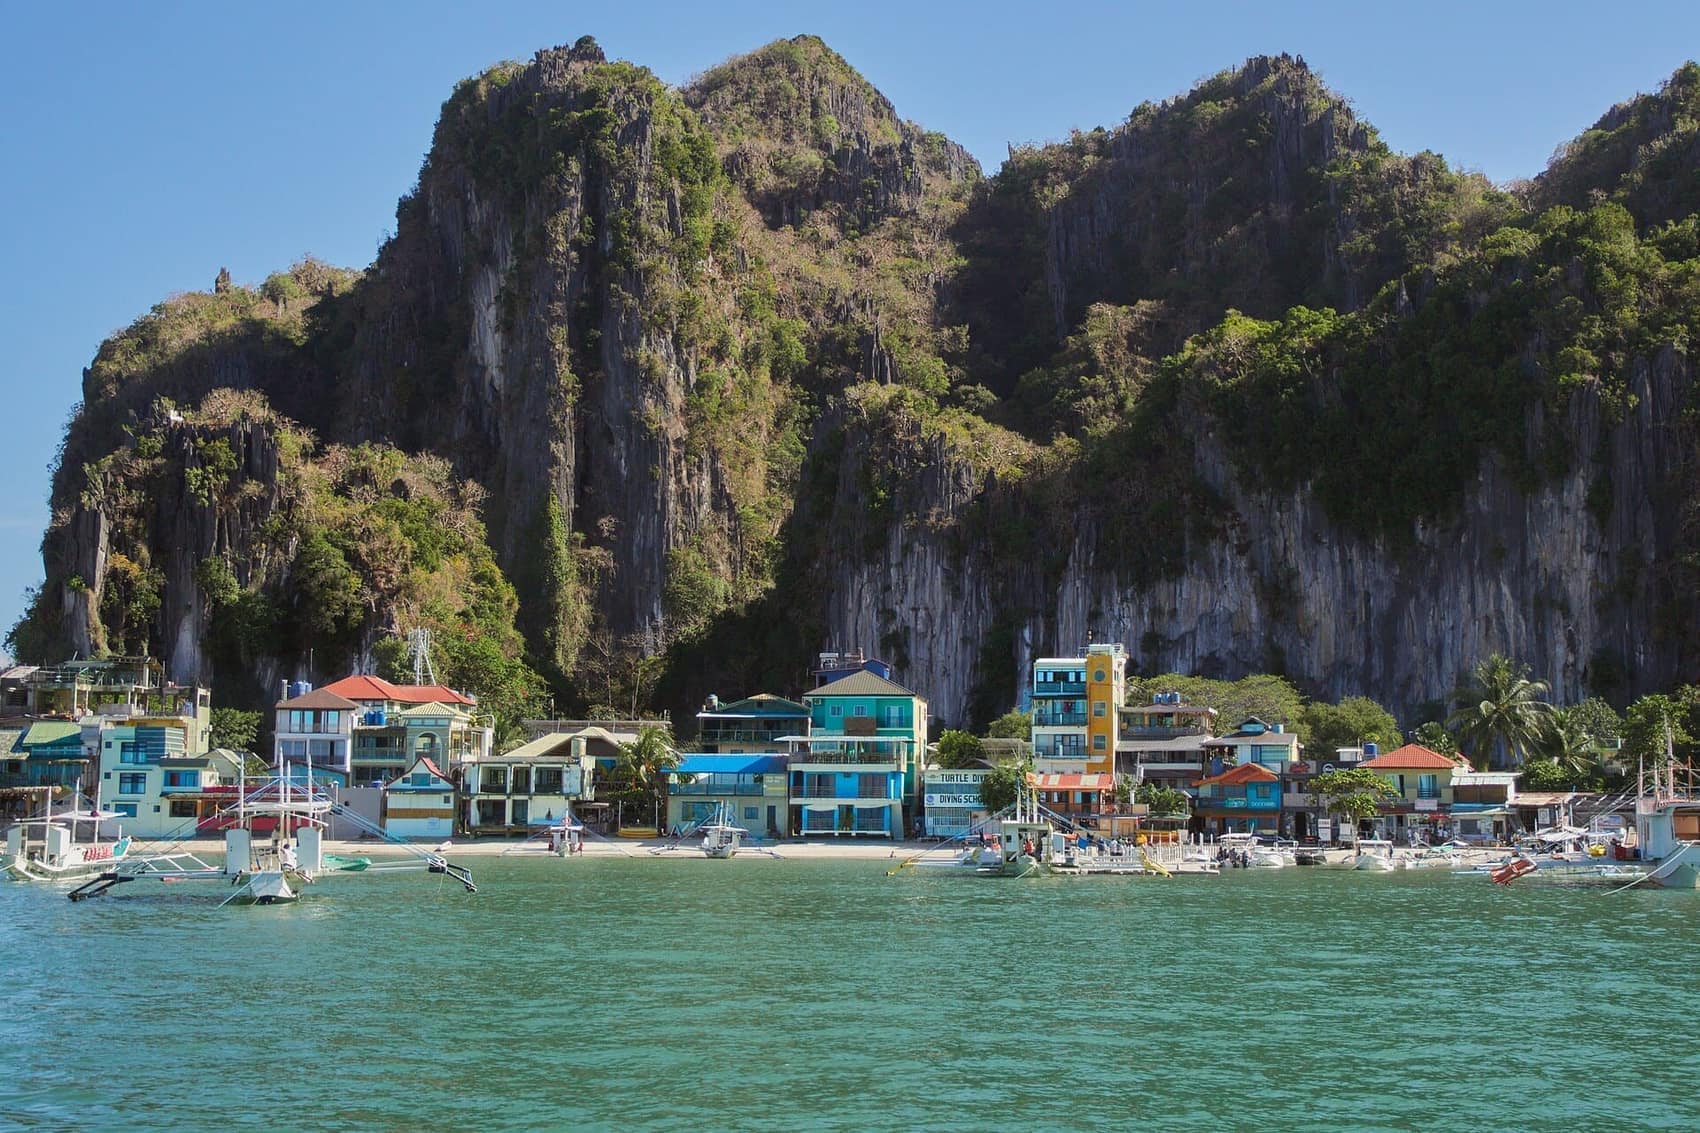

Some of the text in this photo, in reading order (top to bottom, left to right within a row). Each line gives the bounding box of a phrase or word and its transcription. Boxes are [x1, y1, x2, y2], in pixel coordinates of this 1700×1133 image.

[941, 774, 986, 782] TURTLE DIV
[940, 795, 983, 803] DIVING SCHO
